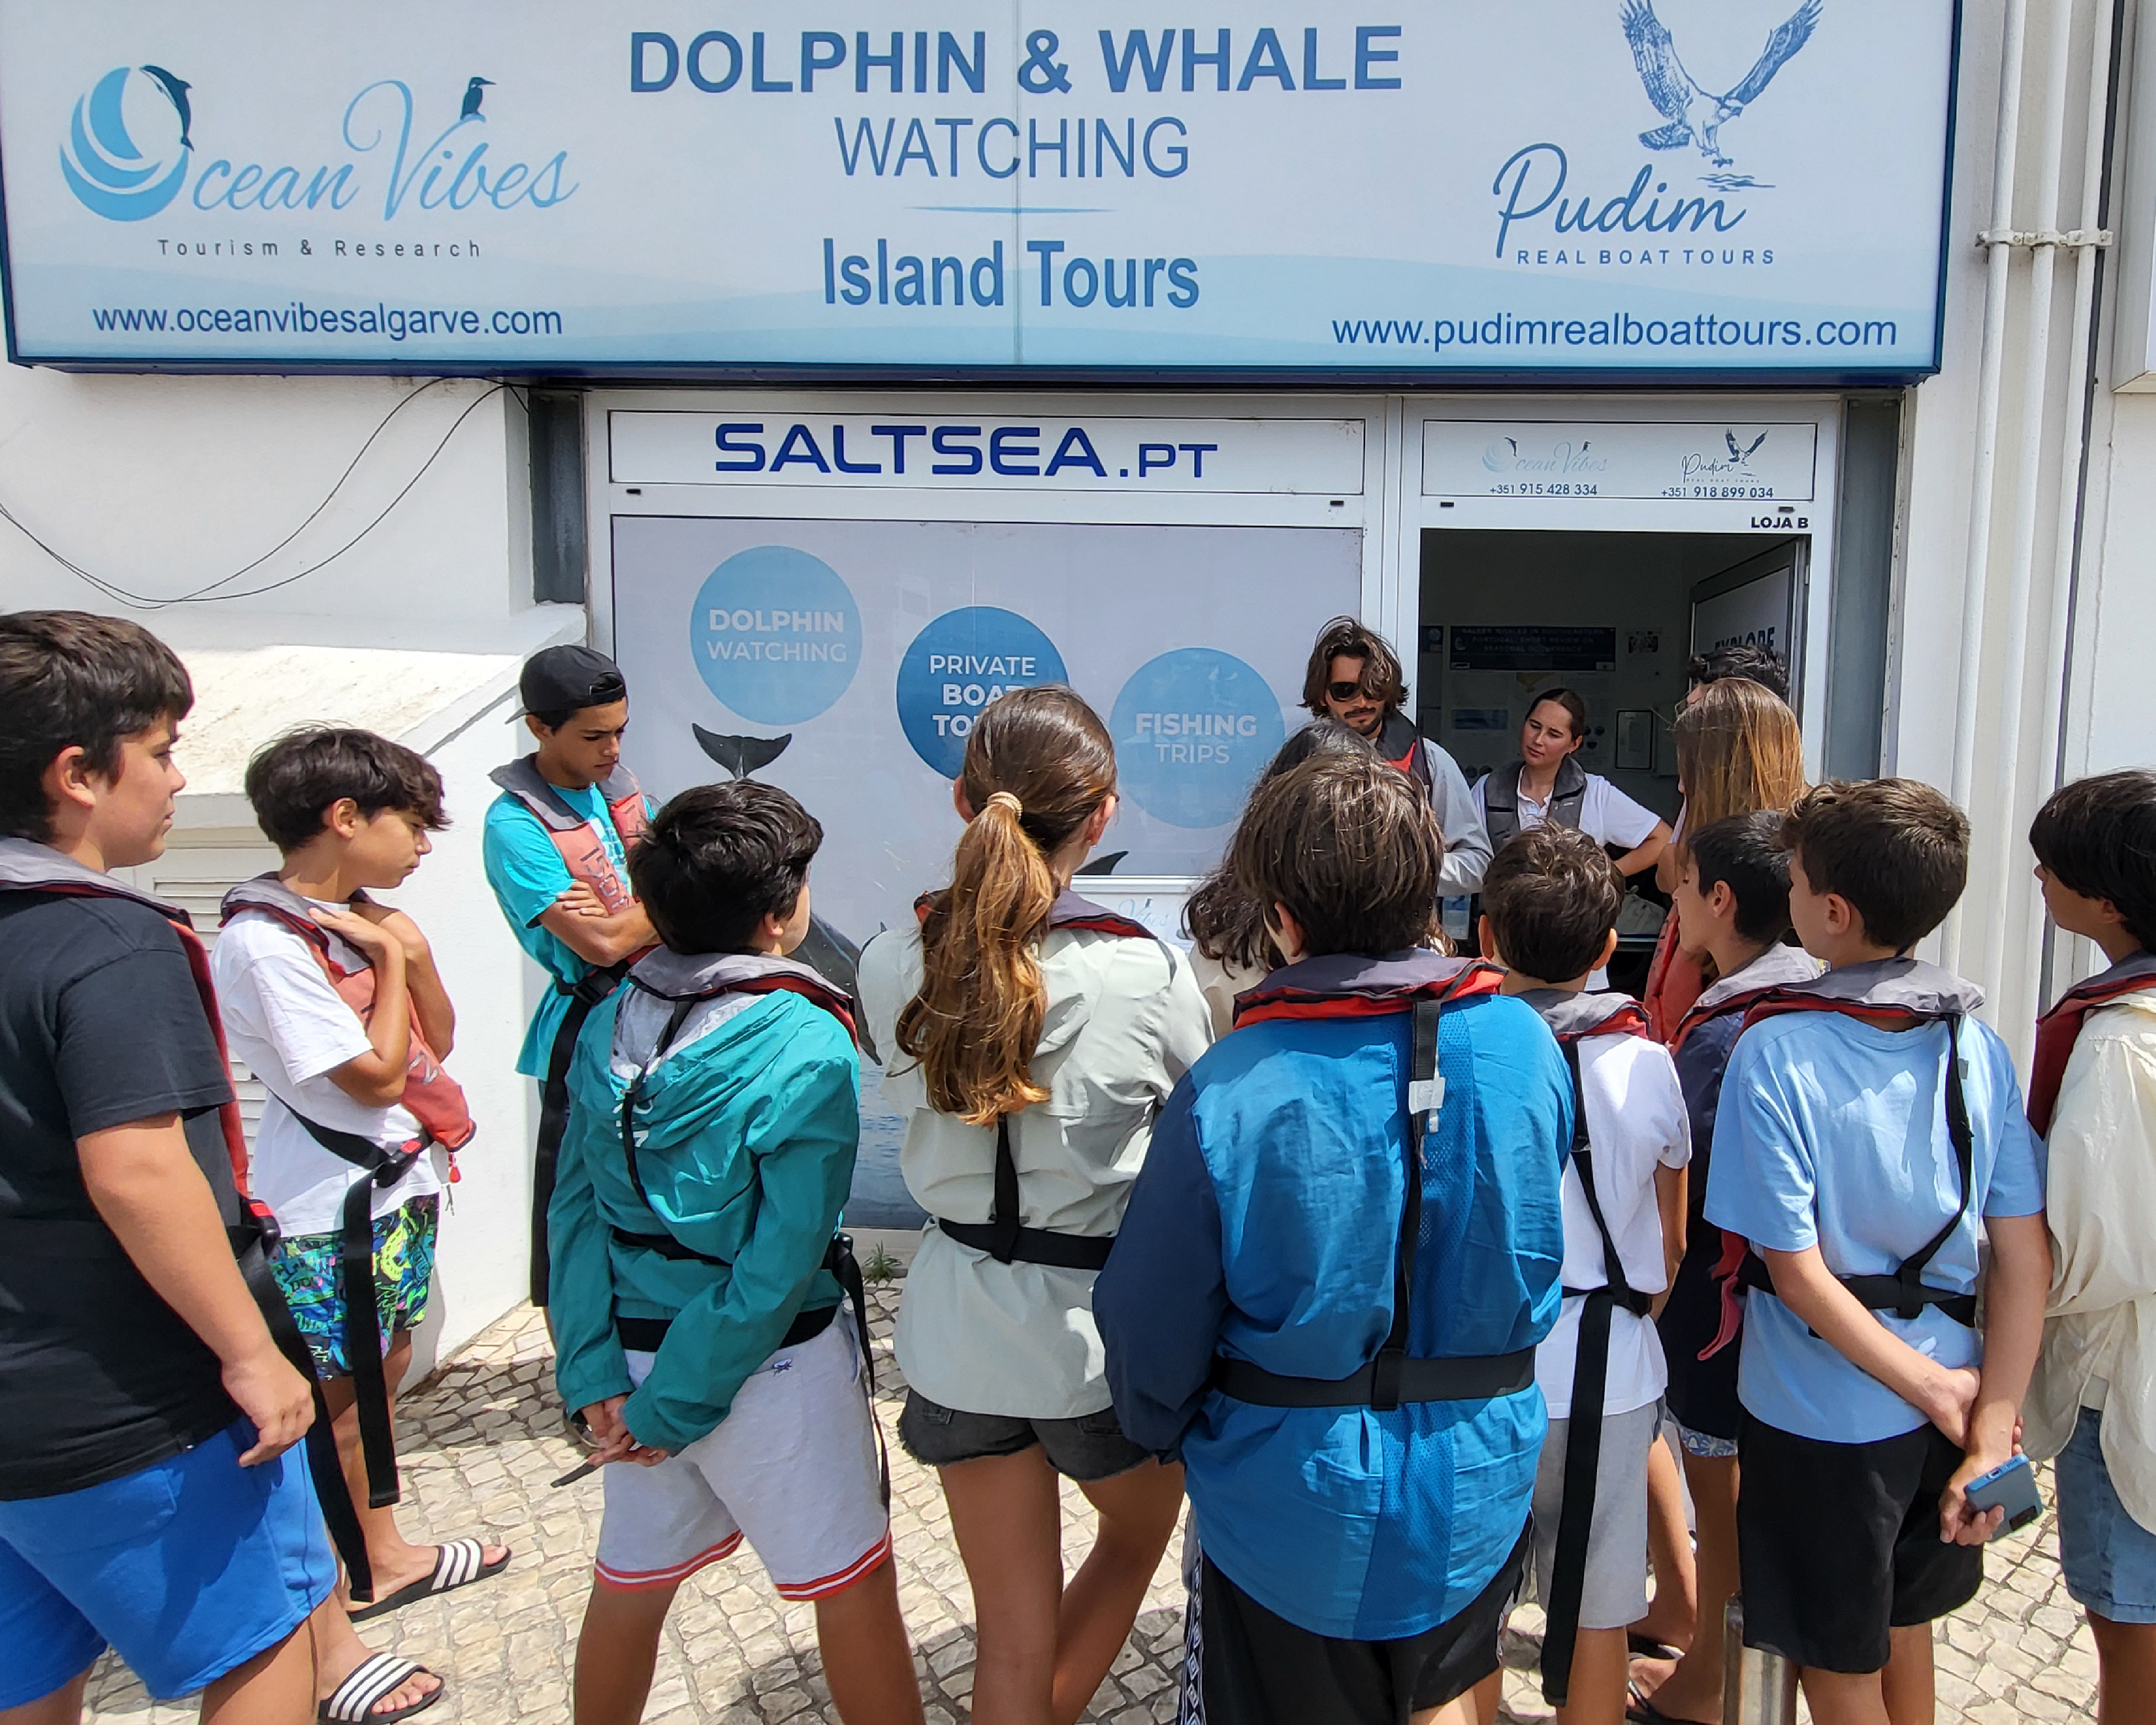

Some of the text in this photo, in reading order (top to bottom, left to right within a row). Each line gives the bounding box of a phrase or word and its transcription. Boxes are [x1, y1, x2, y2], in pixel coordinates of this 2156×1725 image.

[631, 25, 1403, 94] DOLPHIN & WHALE
[60, 64, 579, 222] Ocean Vibes
[834, 116, 1189, 180] WATCHING
[1493, 143, 1747, 258] Pudim
[158, 239, 481, 257] Tourism & Research
[1517, 250, 1774, 264] REAL BOAT TOURS
[823, 237, 1200, 308] Island Tours
[93, 301, 562, 341] www.oceanvibesalgarve.com
[1332, 312, 1897, 353] www.pudimrealboattours.com
[715, 423, 1218, 478] SALTSEA.PT
[1554, 441, 1609, 473] Vibes
[1490, 483, 1597, 496] +351 915 428 334
[1661, 486, 1774, 498] +351 918 899 034
[1751, 516, 1809, 529] LOJA B
[709, 609, 844, 632] DOLPHIN
[706, 640, 847, 662] WATCHING
[929, 655, 1036, 676] PRIVATE
[943, 683, 1025, 707] BOA
[1136, 713, 1257, 737] FISHING
[1154, 744, 1230, 765] TRIPS
